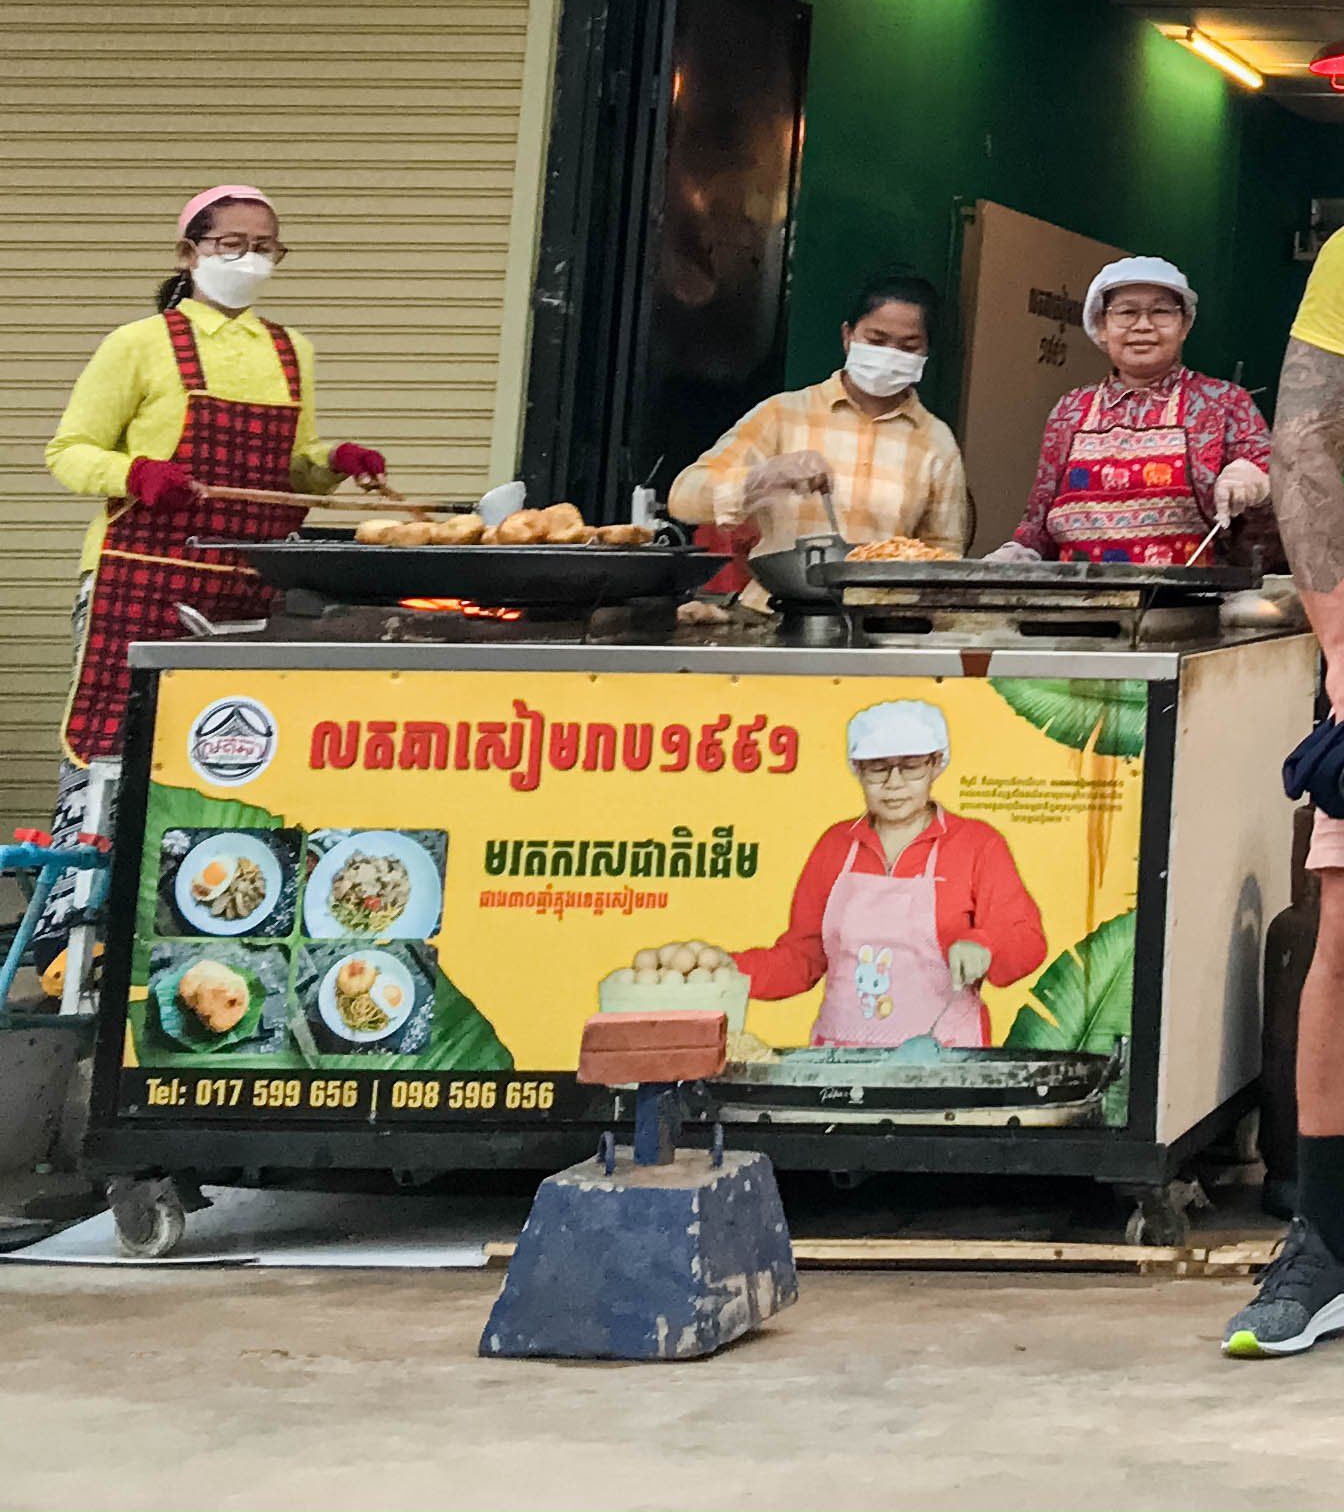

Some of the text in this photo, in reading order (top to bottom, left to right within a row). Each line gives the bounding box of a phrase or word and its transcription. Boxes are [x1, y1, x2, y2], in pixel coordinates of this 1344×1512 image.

[146, 1078, 187, 1106] Tel:
[195, 1079, 243, 1107] 017
[252, 1080, 301, 1108] 599
[309, 1080, 358, 1108] 656
[391, 1081, 439, 1109] 098
[448, 1081, 497, 1109] 596
[506, 1081, 554, 1109] 656
